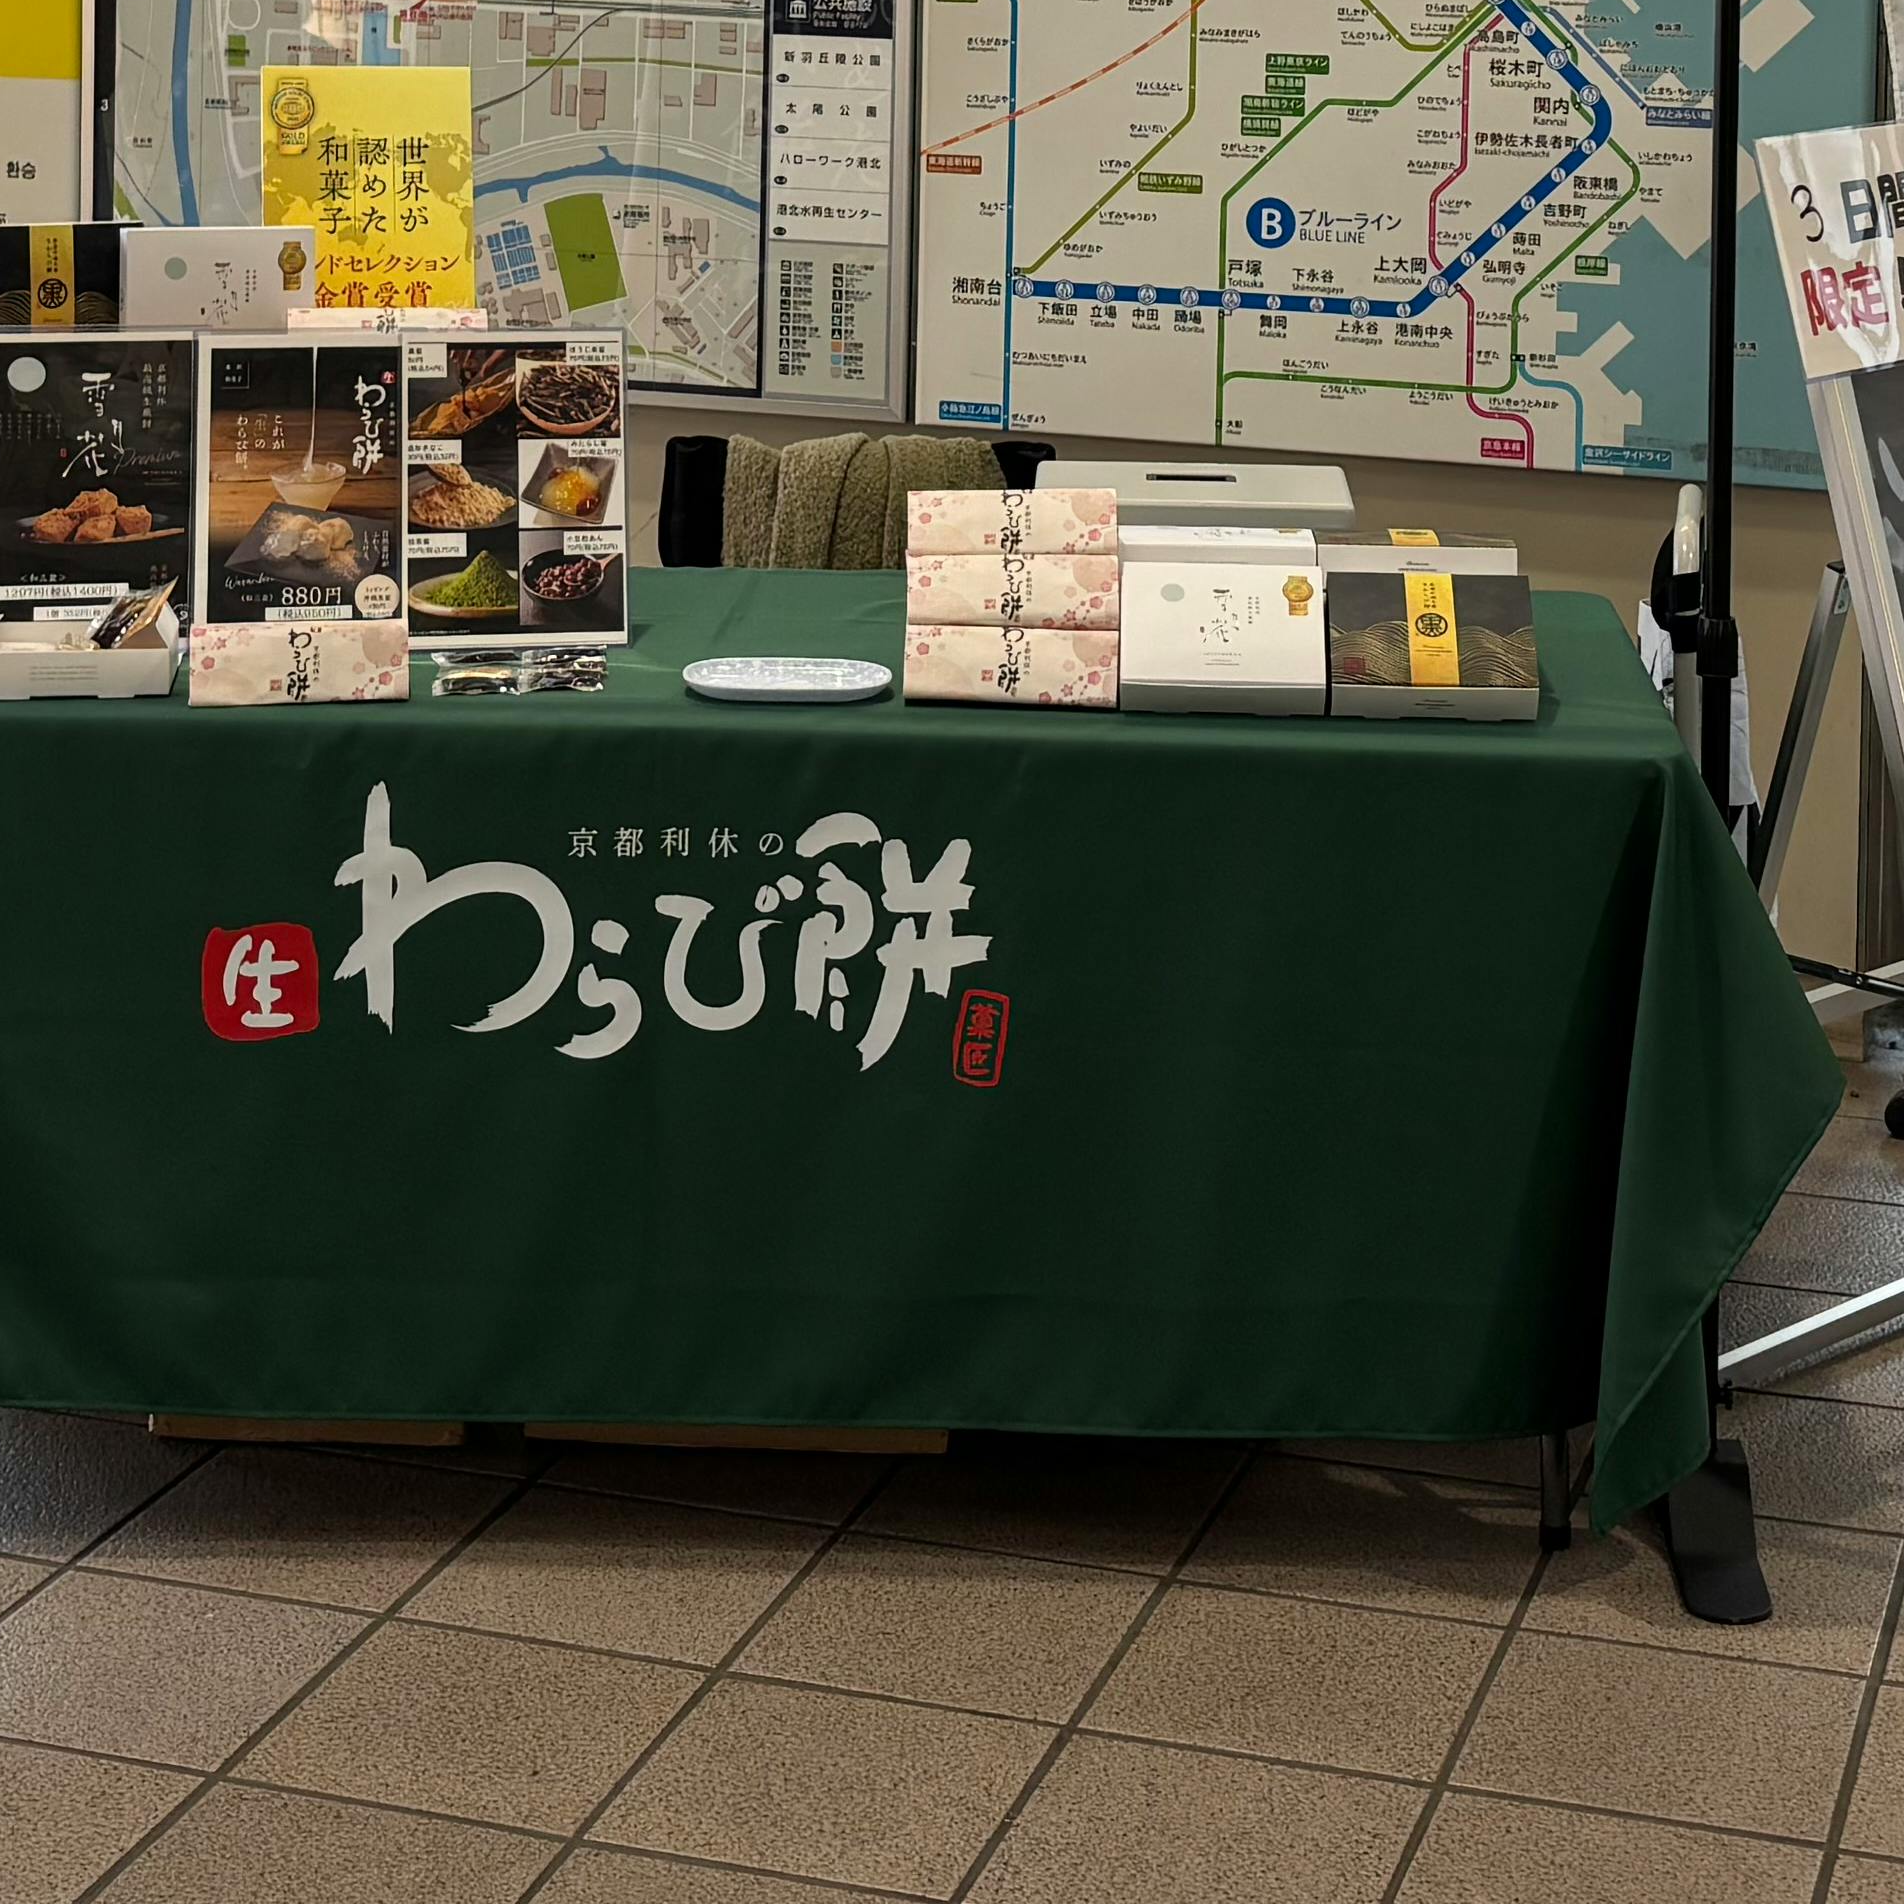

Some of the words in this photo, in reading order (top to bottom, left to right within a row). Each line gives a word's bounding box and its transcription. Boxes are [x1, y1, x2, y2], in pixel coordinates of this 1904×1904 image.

[1488, 59, 1545, 78] 桜木町
[1488, 78, 1552, 93] Sakuragicho
[1533, 97, 1570, 115] 関内
[1533, 115, 1568, 127] Kannai
[1475, 132, 1579, 149] 伊勢佐木長者町
[779, 152, 882, 170] ハローワーク港北
[316, 135, 353, 235] 和菓子
[356, 137, 391, 234] 認めた
[395, 137, 431, 234] 世界が
[1573, 176, 1619, 191] 阪東橋
[776, 203, 884, 221] 港北水再生センター
[1298, 208, 1403, 232] ブルーライン
[1543, 204, 1587, 219] 吉野町
[1260, 207, 1284, 240] B
[1299, 228, 1333, 243] BLUE
[1335, 231, 1366, 245] LINE
[1227, 258, 1263, 277] 戸塚
[1374, 255, 1428, 275] 上大岡
[1482, 259, 1526, 275] 弘明寺
[1292, 268, 1335, 284] 下永谷
[314, 280, 433, 309] 金賞受賞
[952, 276, 1003, 295] 湘南台
[1037, 302, 1078, 317] 下飯田
[1089, 304, 1118, 319] 立場
[1132, 307, 1159, 322] 中田
[1336, 320, 1379, 335] 上永谷
[1395, 323, 1454, 341] 港南中央
[352, 375, 387, 475] わらび餅
[281, 586, 342, 606] 880円
[567, 827, 783, 858] 京都利休の
[332, 779, 994, 1072] わらび餅
[222, 933, 299, 1027] 生
[963, 1001, 1001, 1078] 菓匠
